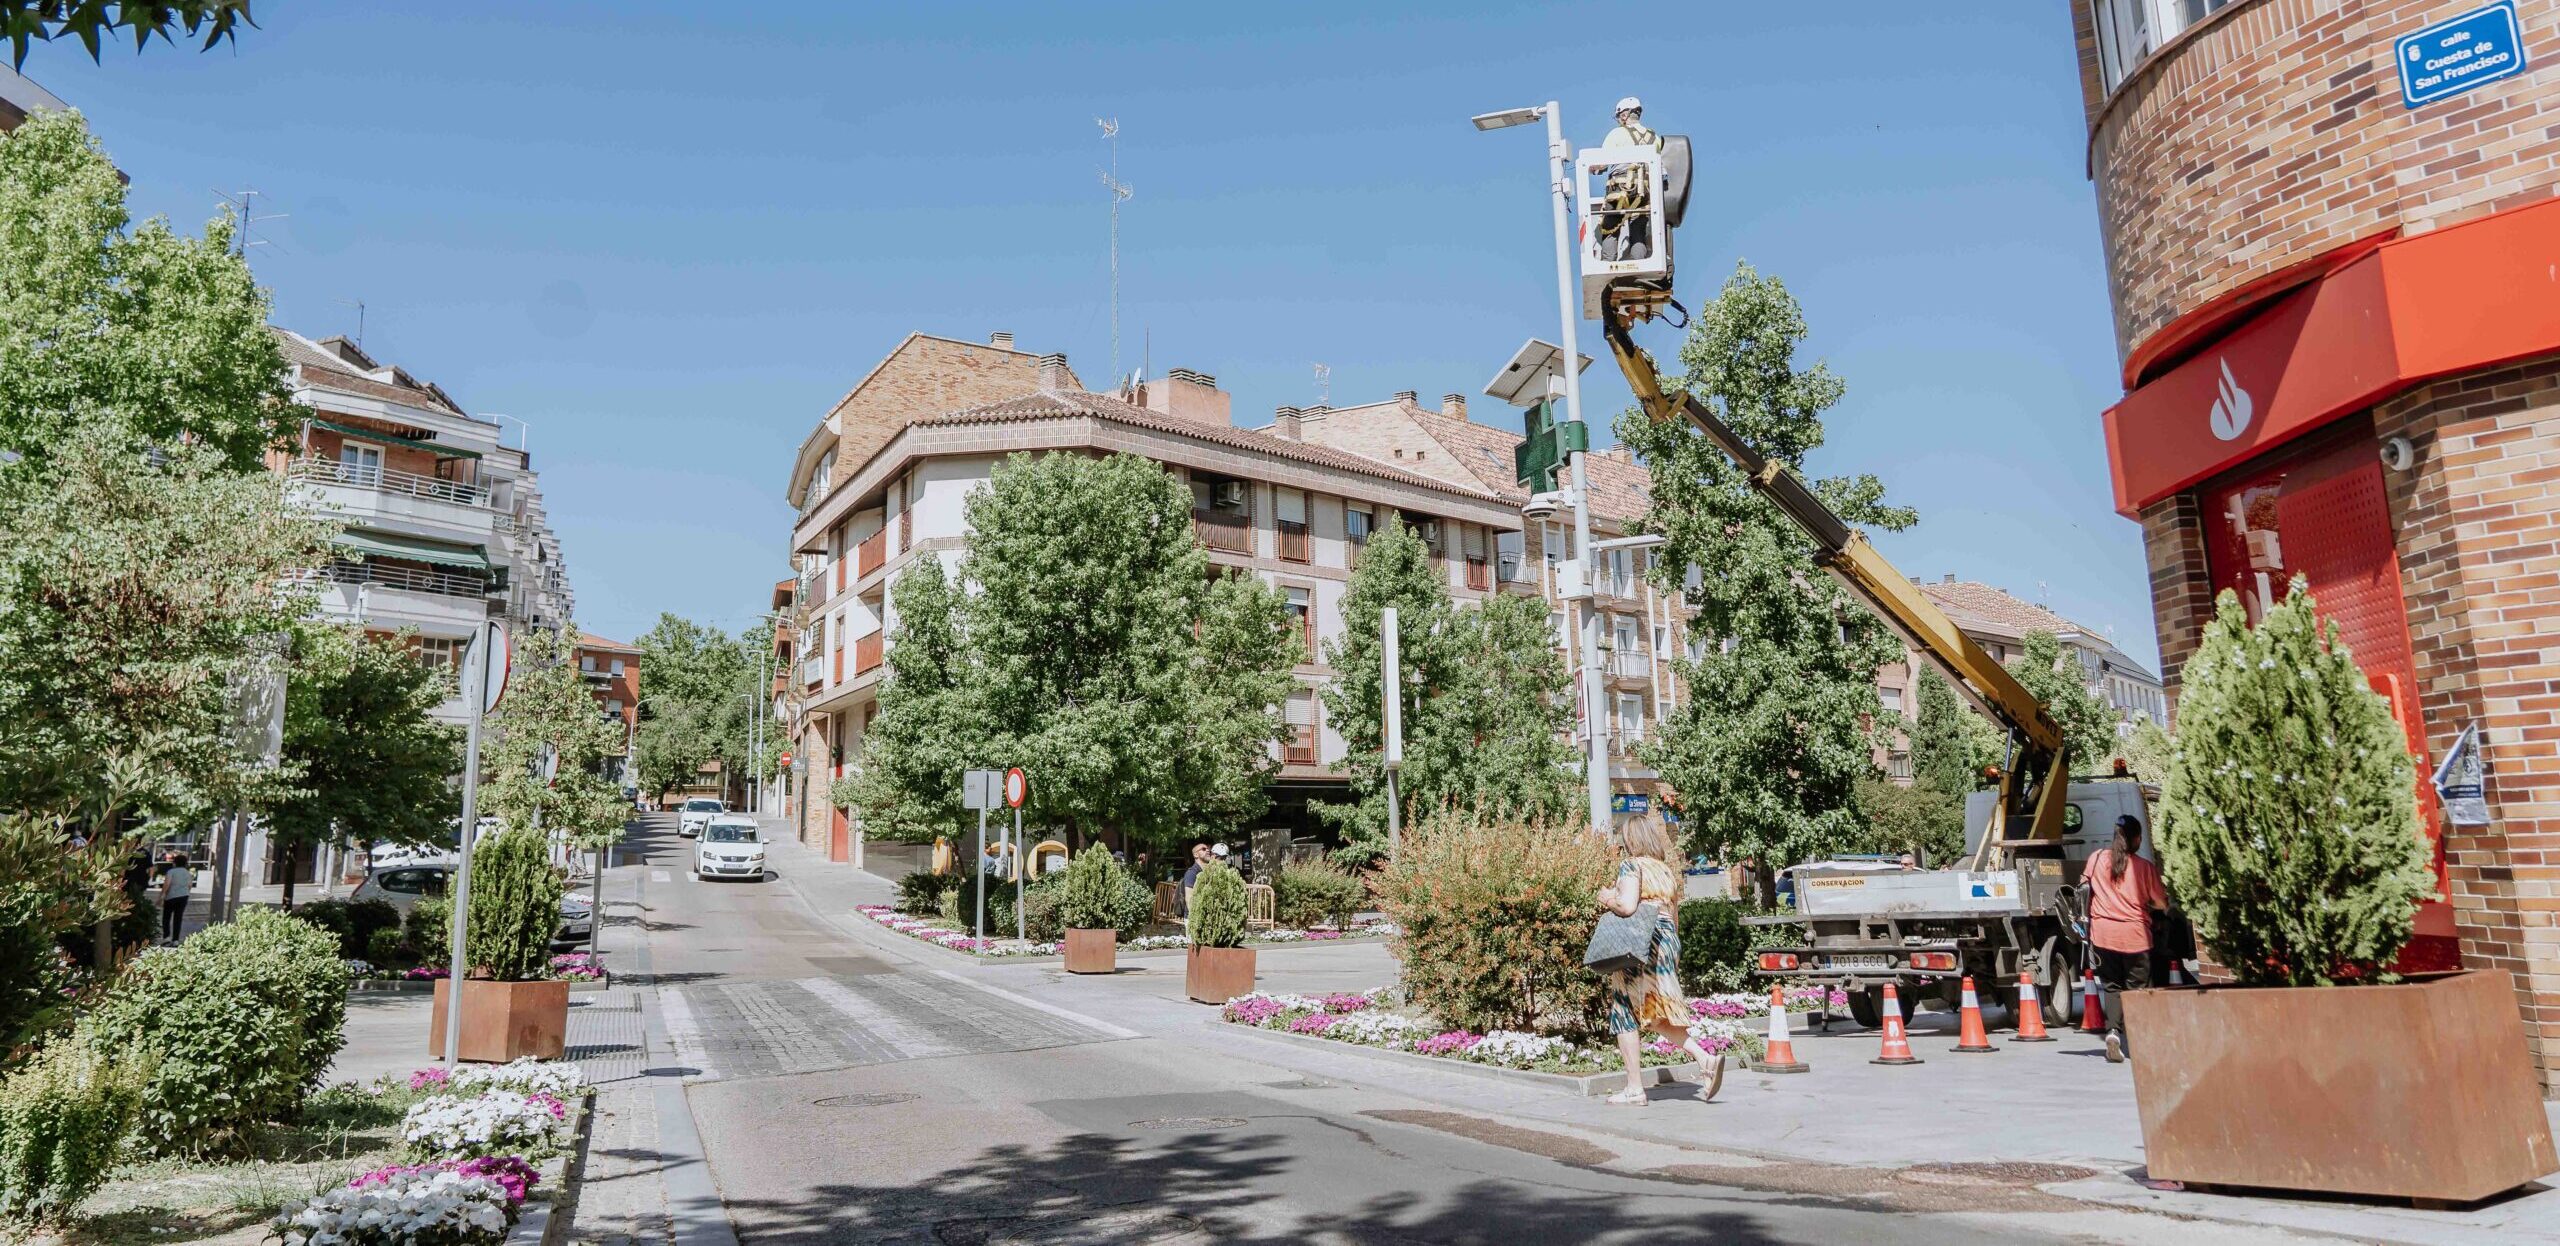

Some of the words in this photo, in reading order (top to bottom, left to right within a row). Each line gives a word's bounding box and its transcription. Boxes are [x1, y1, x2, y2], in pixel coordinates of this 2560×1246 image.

[2440, 31, 2471, 48] calle
[2425, 49, 2473, 71] Cuesta
[2474, 41, 2493, 54] de
[2415, 75, 2442, 90] San
[2444, 52, 2509, 80] Francisco
[1833, 956, 1859, 967] 7018
